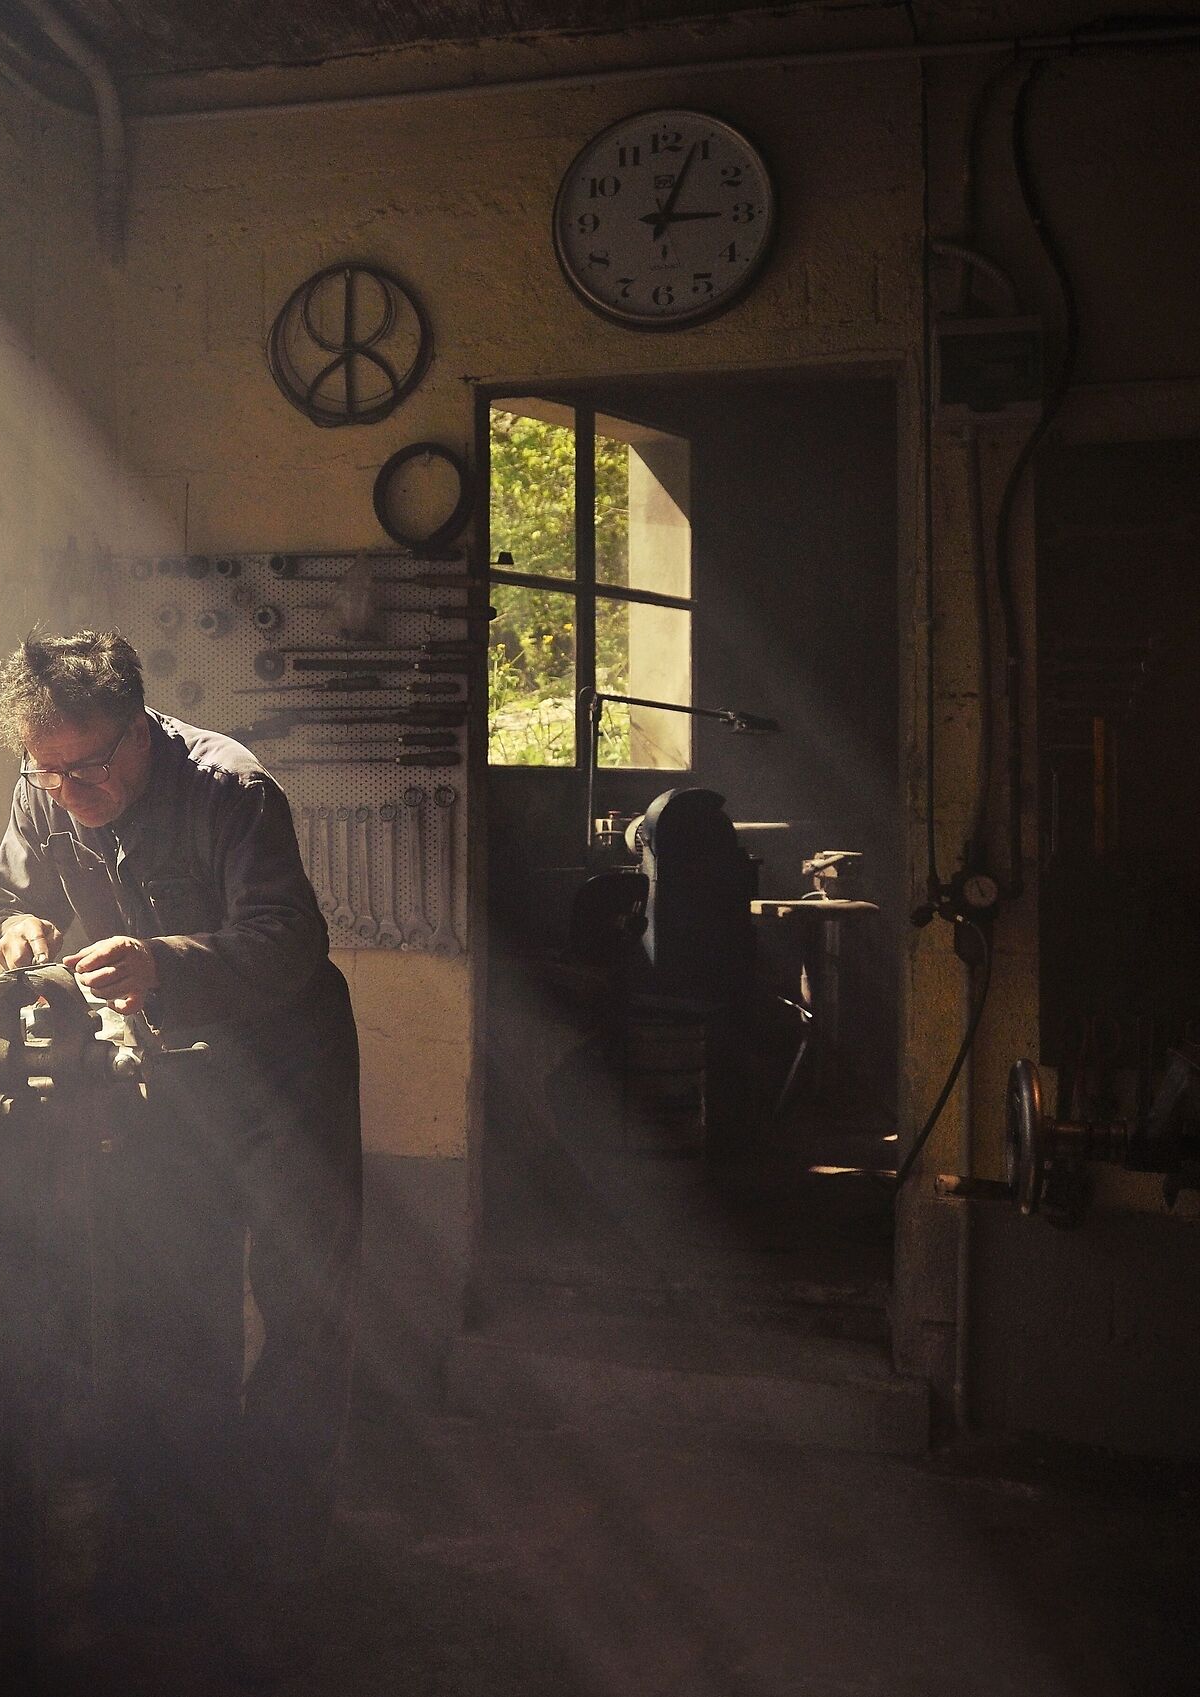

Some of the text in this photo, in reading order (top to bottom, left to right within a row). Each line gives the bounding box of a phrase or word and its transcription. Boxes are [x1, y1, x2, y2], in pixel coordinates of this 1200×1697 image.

[651, 132, 683, 154] 12
[701, 139, 710, 160] 1
[619, 146, 640, 167] 11
[589, 176, 621, 198] 10
[720, 166, 742, 187] 2
[578, 213, 600, 233] 9
[733, 203, 755, 223] 3
[588, 250, 610, 270] 8
[718, 241, 741, 262] 4
[617, 277, 637, 298] 7
[692, 273, 713, 293] 5
[652, 286, 674, 306] 6
